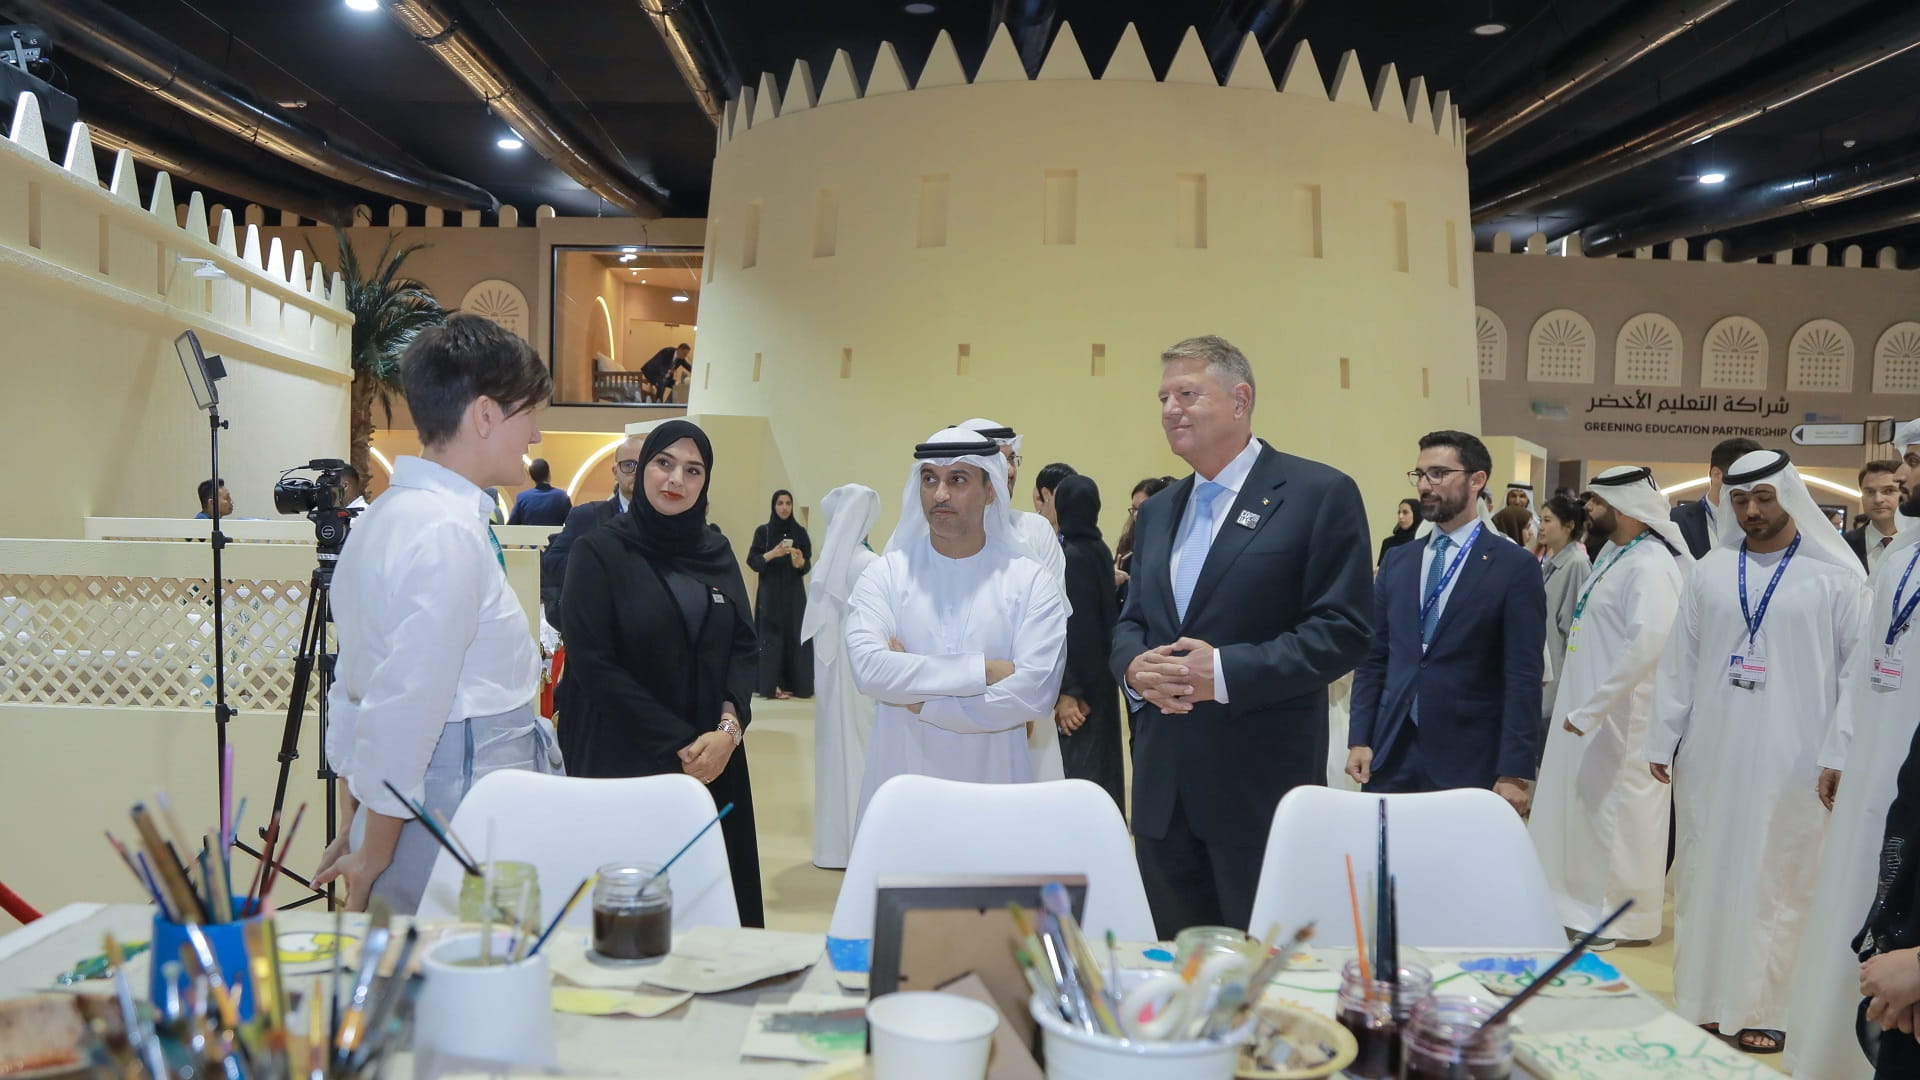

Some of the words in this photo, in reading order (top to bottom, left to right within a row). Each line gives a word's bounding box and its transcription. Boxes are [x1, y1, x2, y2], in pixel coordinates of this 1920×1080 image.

[1585, 389, 1652, 413] الأخضر
[1656, 394, 1718, 414] التعليم
[1723, 395, 1789, 418] شراكة
[1584, 421, 1643, 433] GREENING
[1645, 423, 1710, 435] EDUCATION
[1712, 425, 1788, 437] PARTNERSHIP
